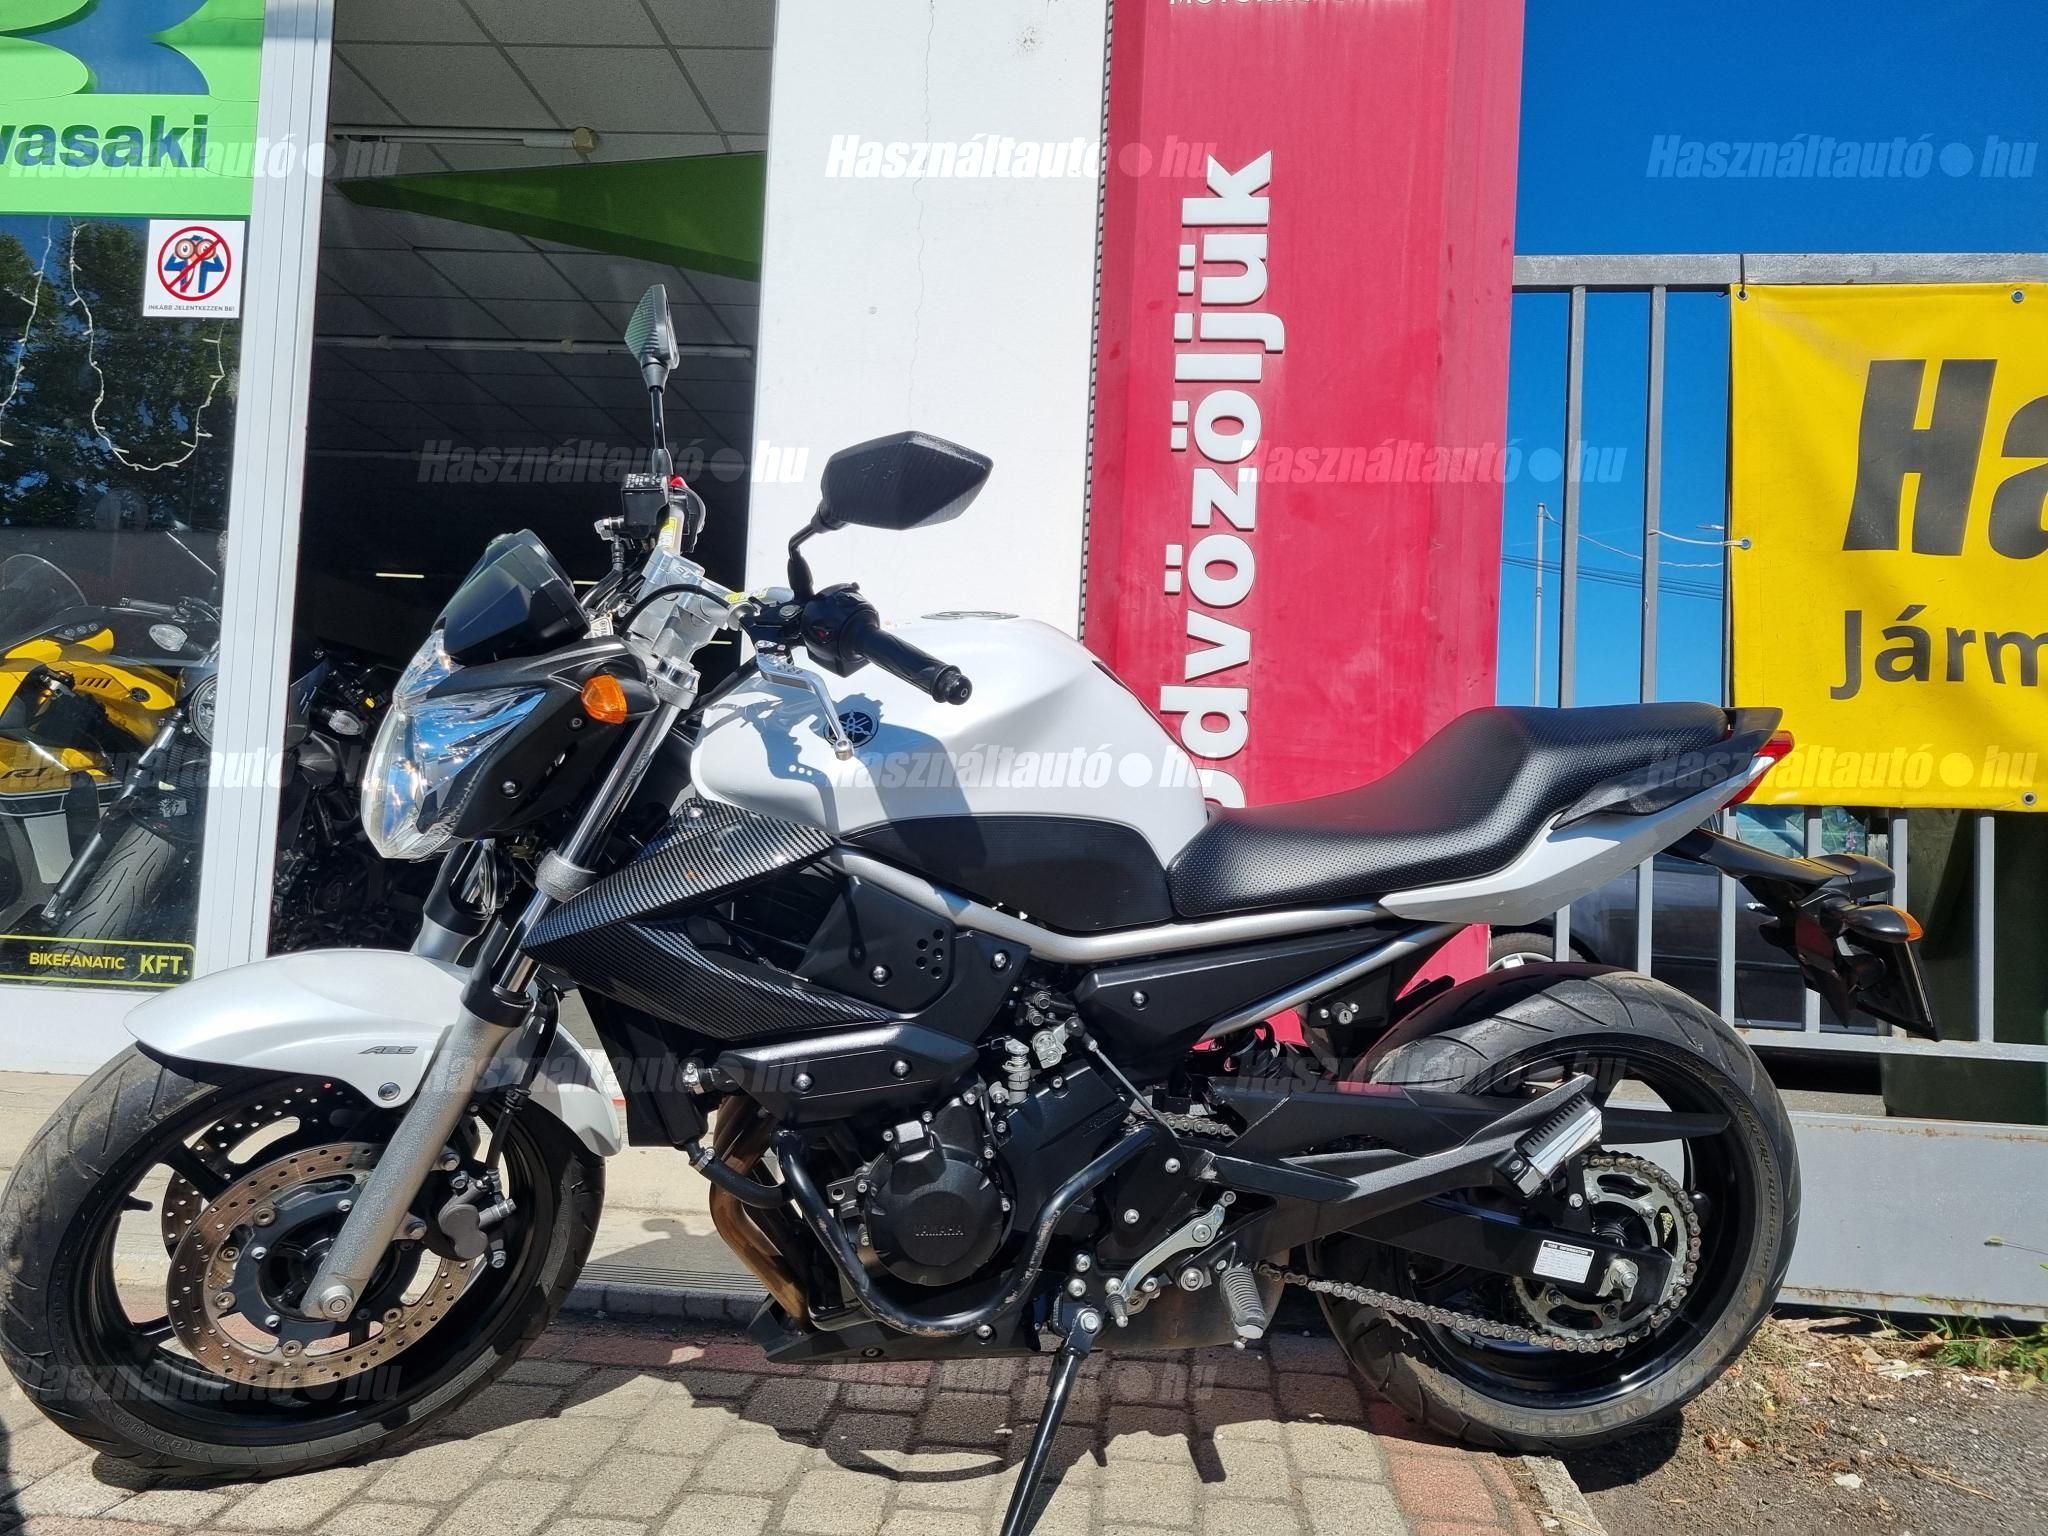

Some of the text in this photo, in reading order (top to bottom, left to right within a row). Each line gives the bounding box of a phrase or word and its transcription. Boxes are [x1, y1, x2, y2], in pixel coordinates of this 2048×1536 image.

[0, 114, 208, 168] asaki
[29, 952, 189, 976] BIKEFANATIC KFT.
